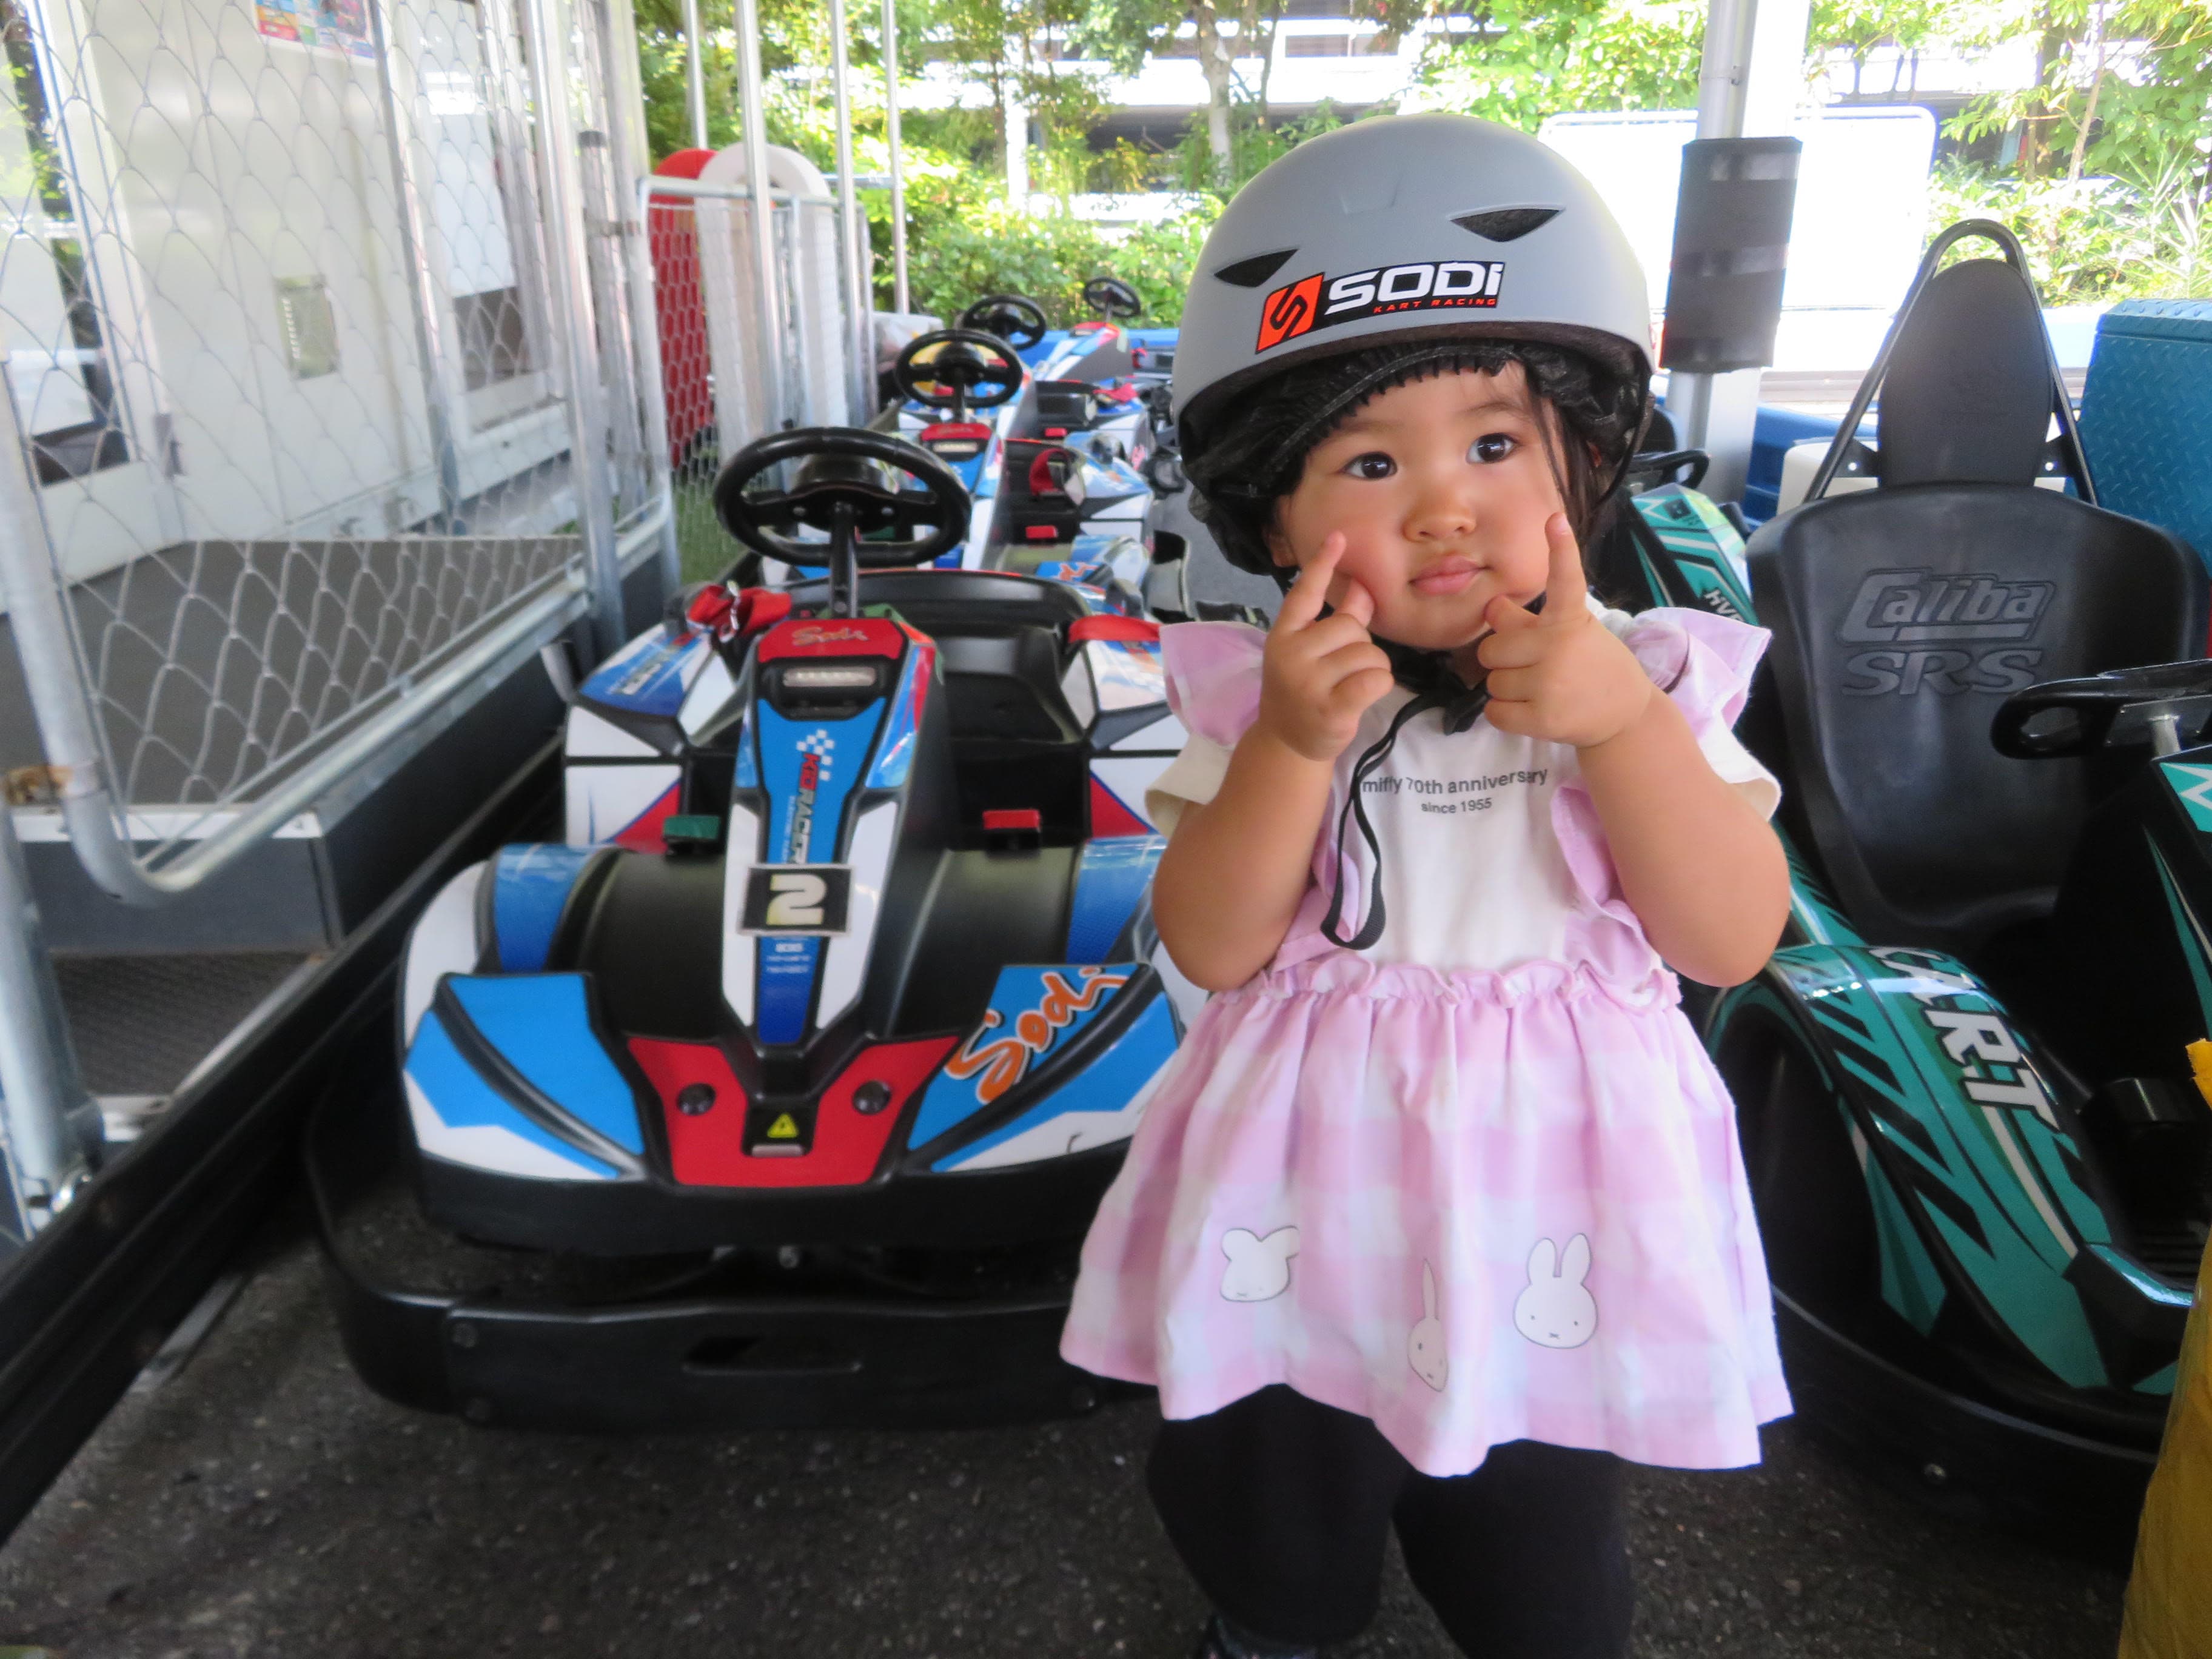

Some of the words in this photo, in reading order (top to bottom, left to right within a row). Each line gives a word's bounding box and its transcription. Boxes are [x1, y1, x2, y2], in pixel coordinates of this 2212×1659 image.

[1372, 301, 1422, 314] KART
[1431, 298, 1497, 307] RACING
[1842, 649, 2042, 696] SRS
[1363, 777, 1402, 794] miffy
[1406, 777, 1443, 795] 70th
[1447, 769, 1548, 794] anniversary
[1421, 802, 1456, 814] since
[1460, 797, 1493, 813] 1955
[766, 873, 827, 925] 2
